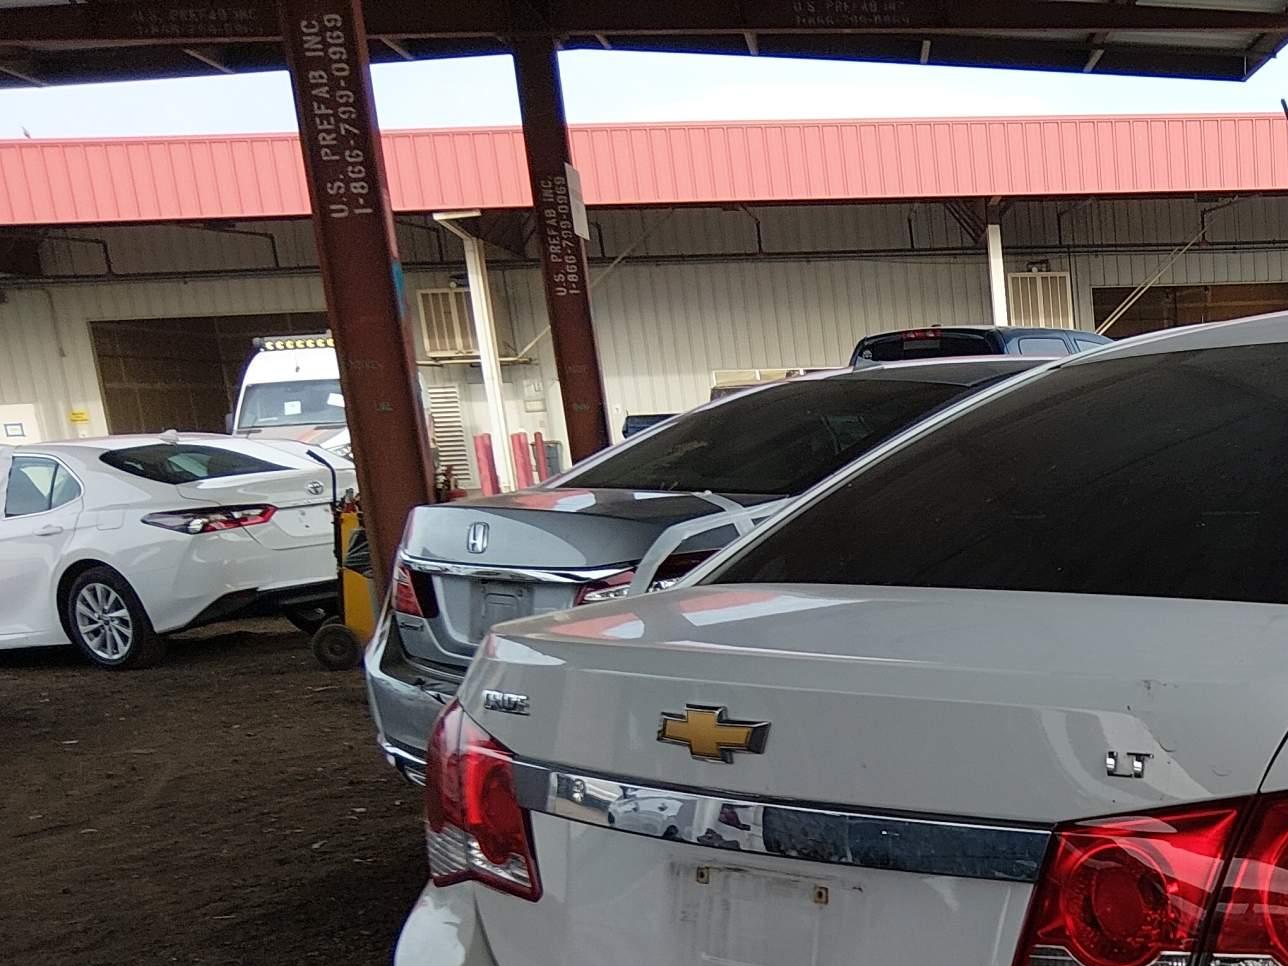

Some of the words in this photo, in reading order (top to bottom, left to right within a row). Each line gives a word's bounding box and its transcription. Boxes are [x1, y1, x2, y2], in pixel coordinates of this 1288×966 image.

[300, 19, 325, 57] INC
[308, 69, 340, 162] PREFAB
[323, 13, 373, 216] 1-866-799-0969
[326, 174, 350, 218] U.S.
[544, 210, 562, 263] PREFAB
[1105, 751, 1154, 778] LT
